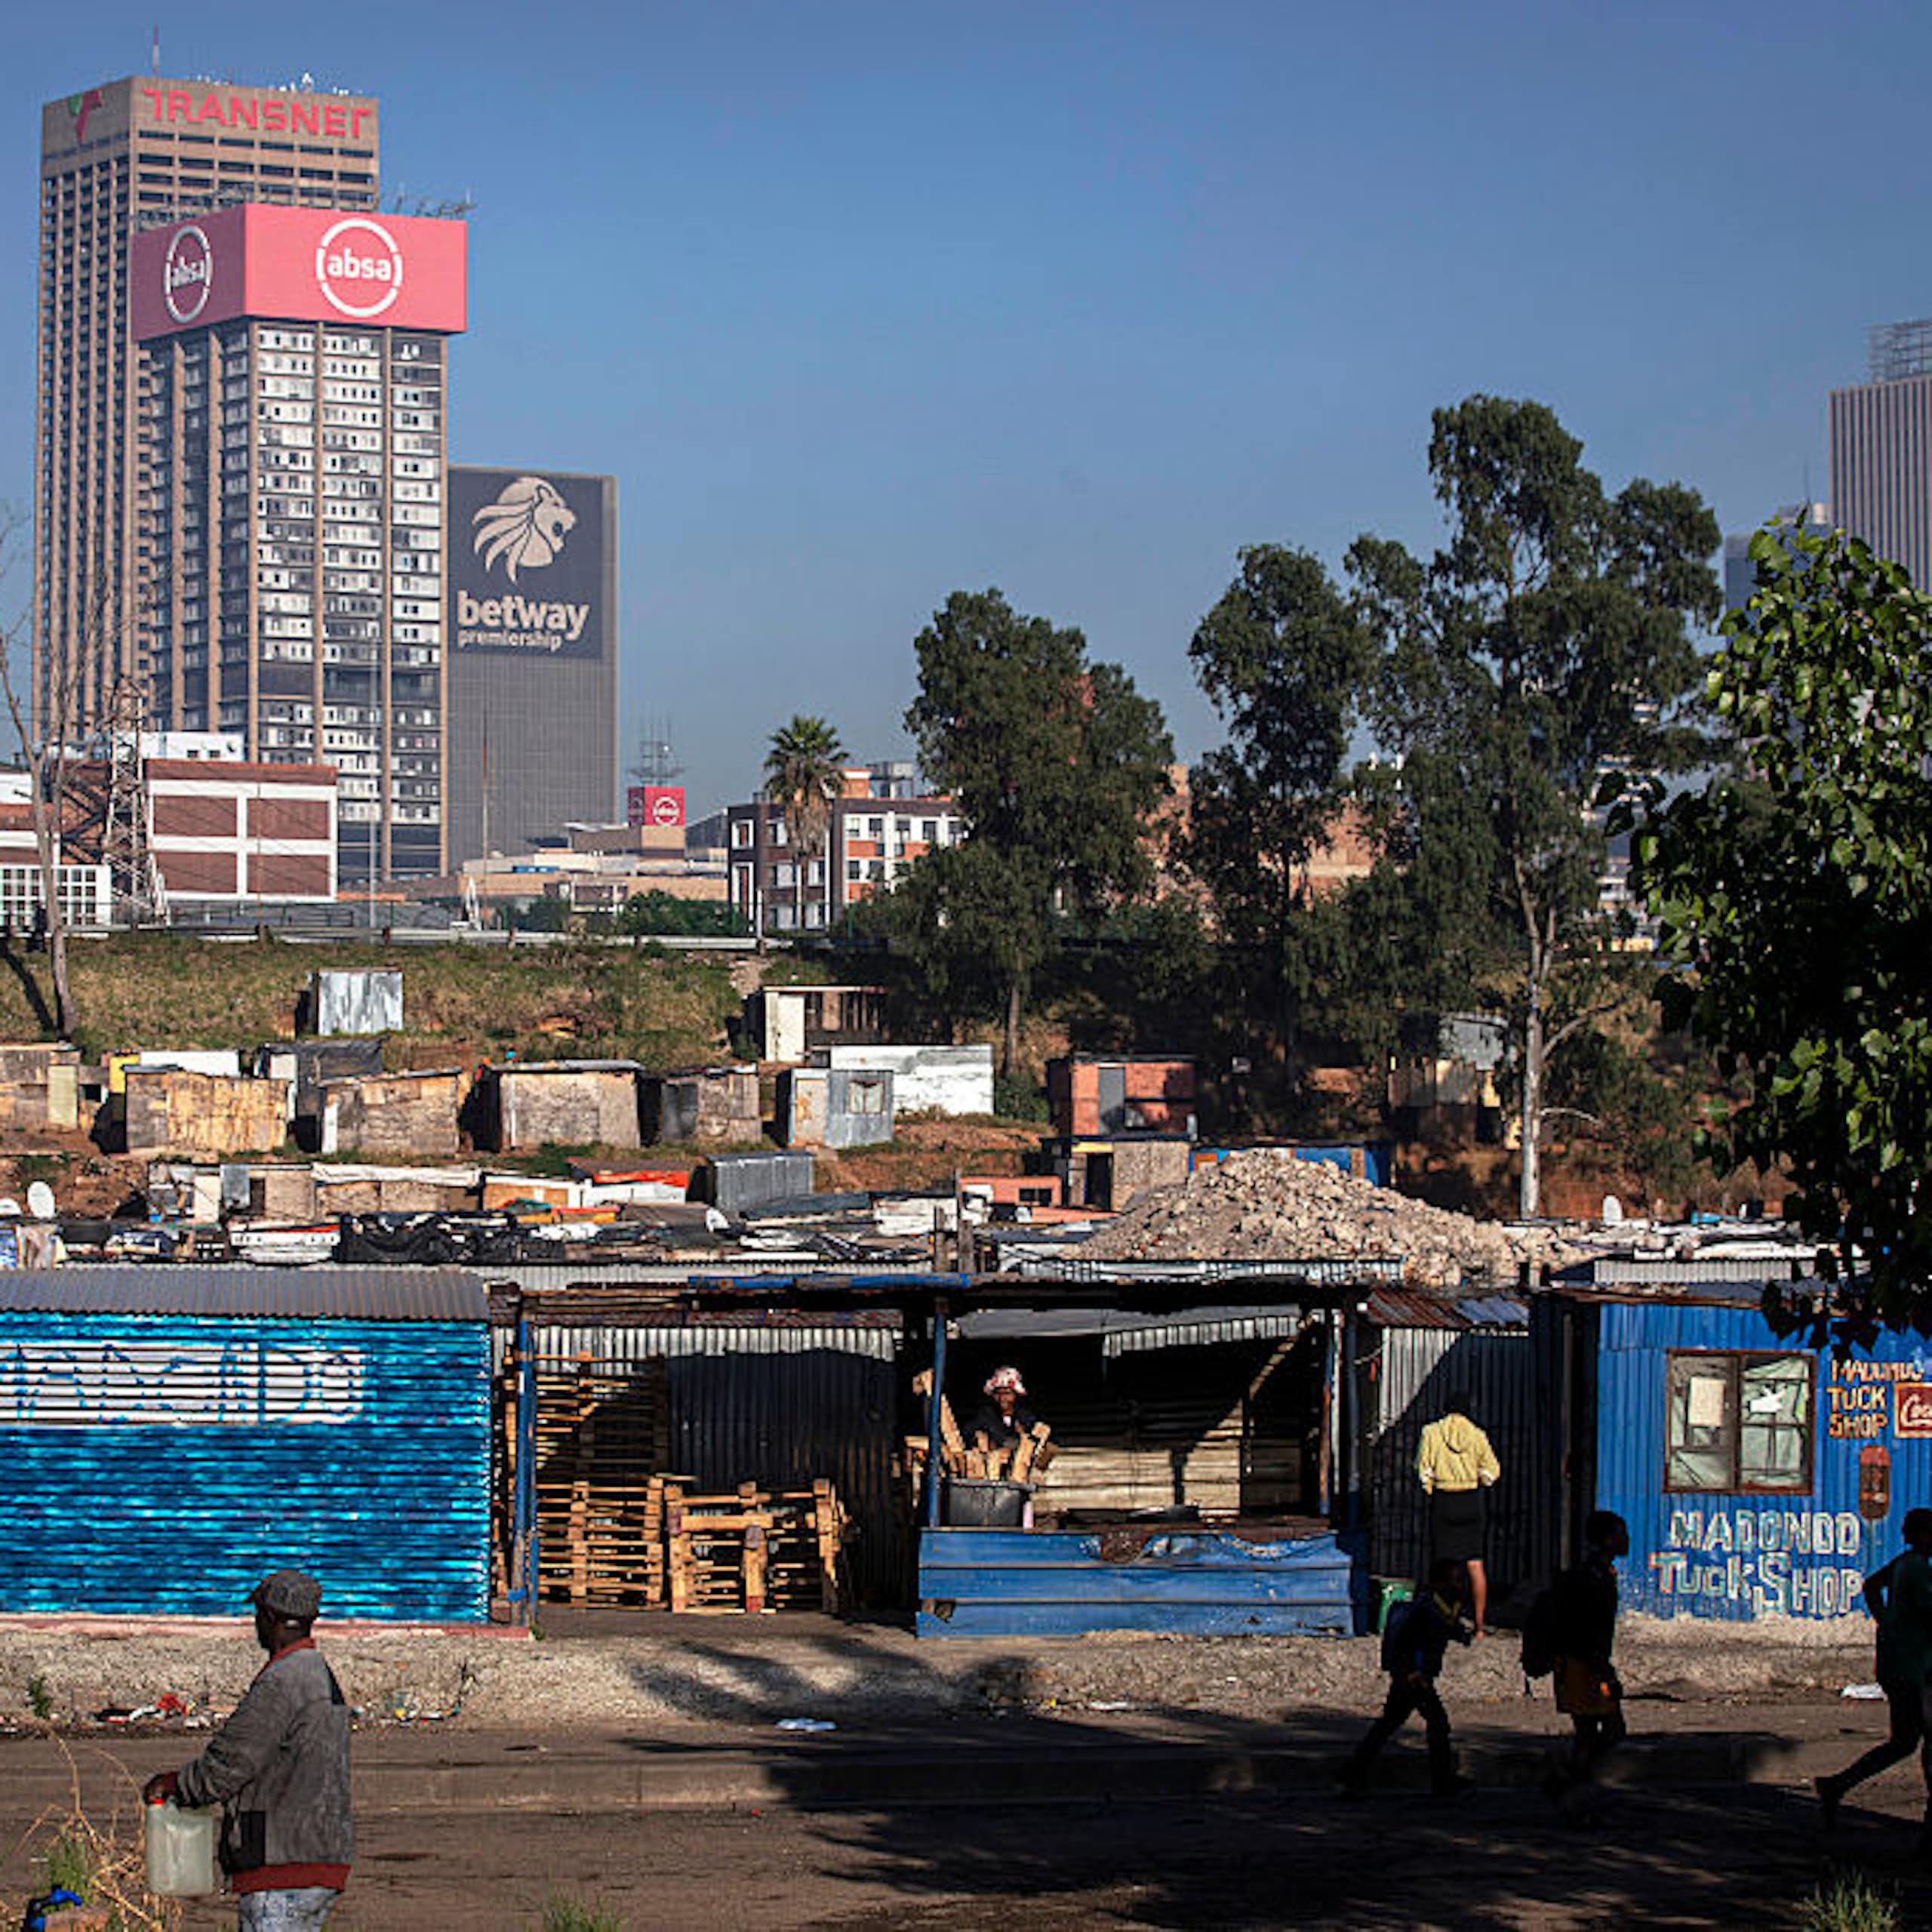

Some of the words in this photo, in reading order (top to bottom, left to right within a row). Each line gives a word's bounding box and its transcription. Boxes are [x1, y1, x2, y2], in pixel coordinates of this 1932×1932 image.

[143, 88, 372, 138] TRANSNET
[327, 248, 392, 281] absa
[457, 589, 589, 640] betway
[1826, 1386, 1886, 1411] TUCK
[1829, 1413, 1887, 1438] SHOP
